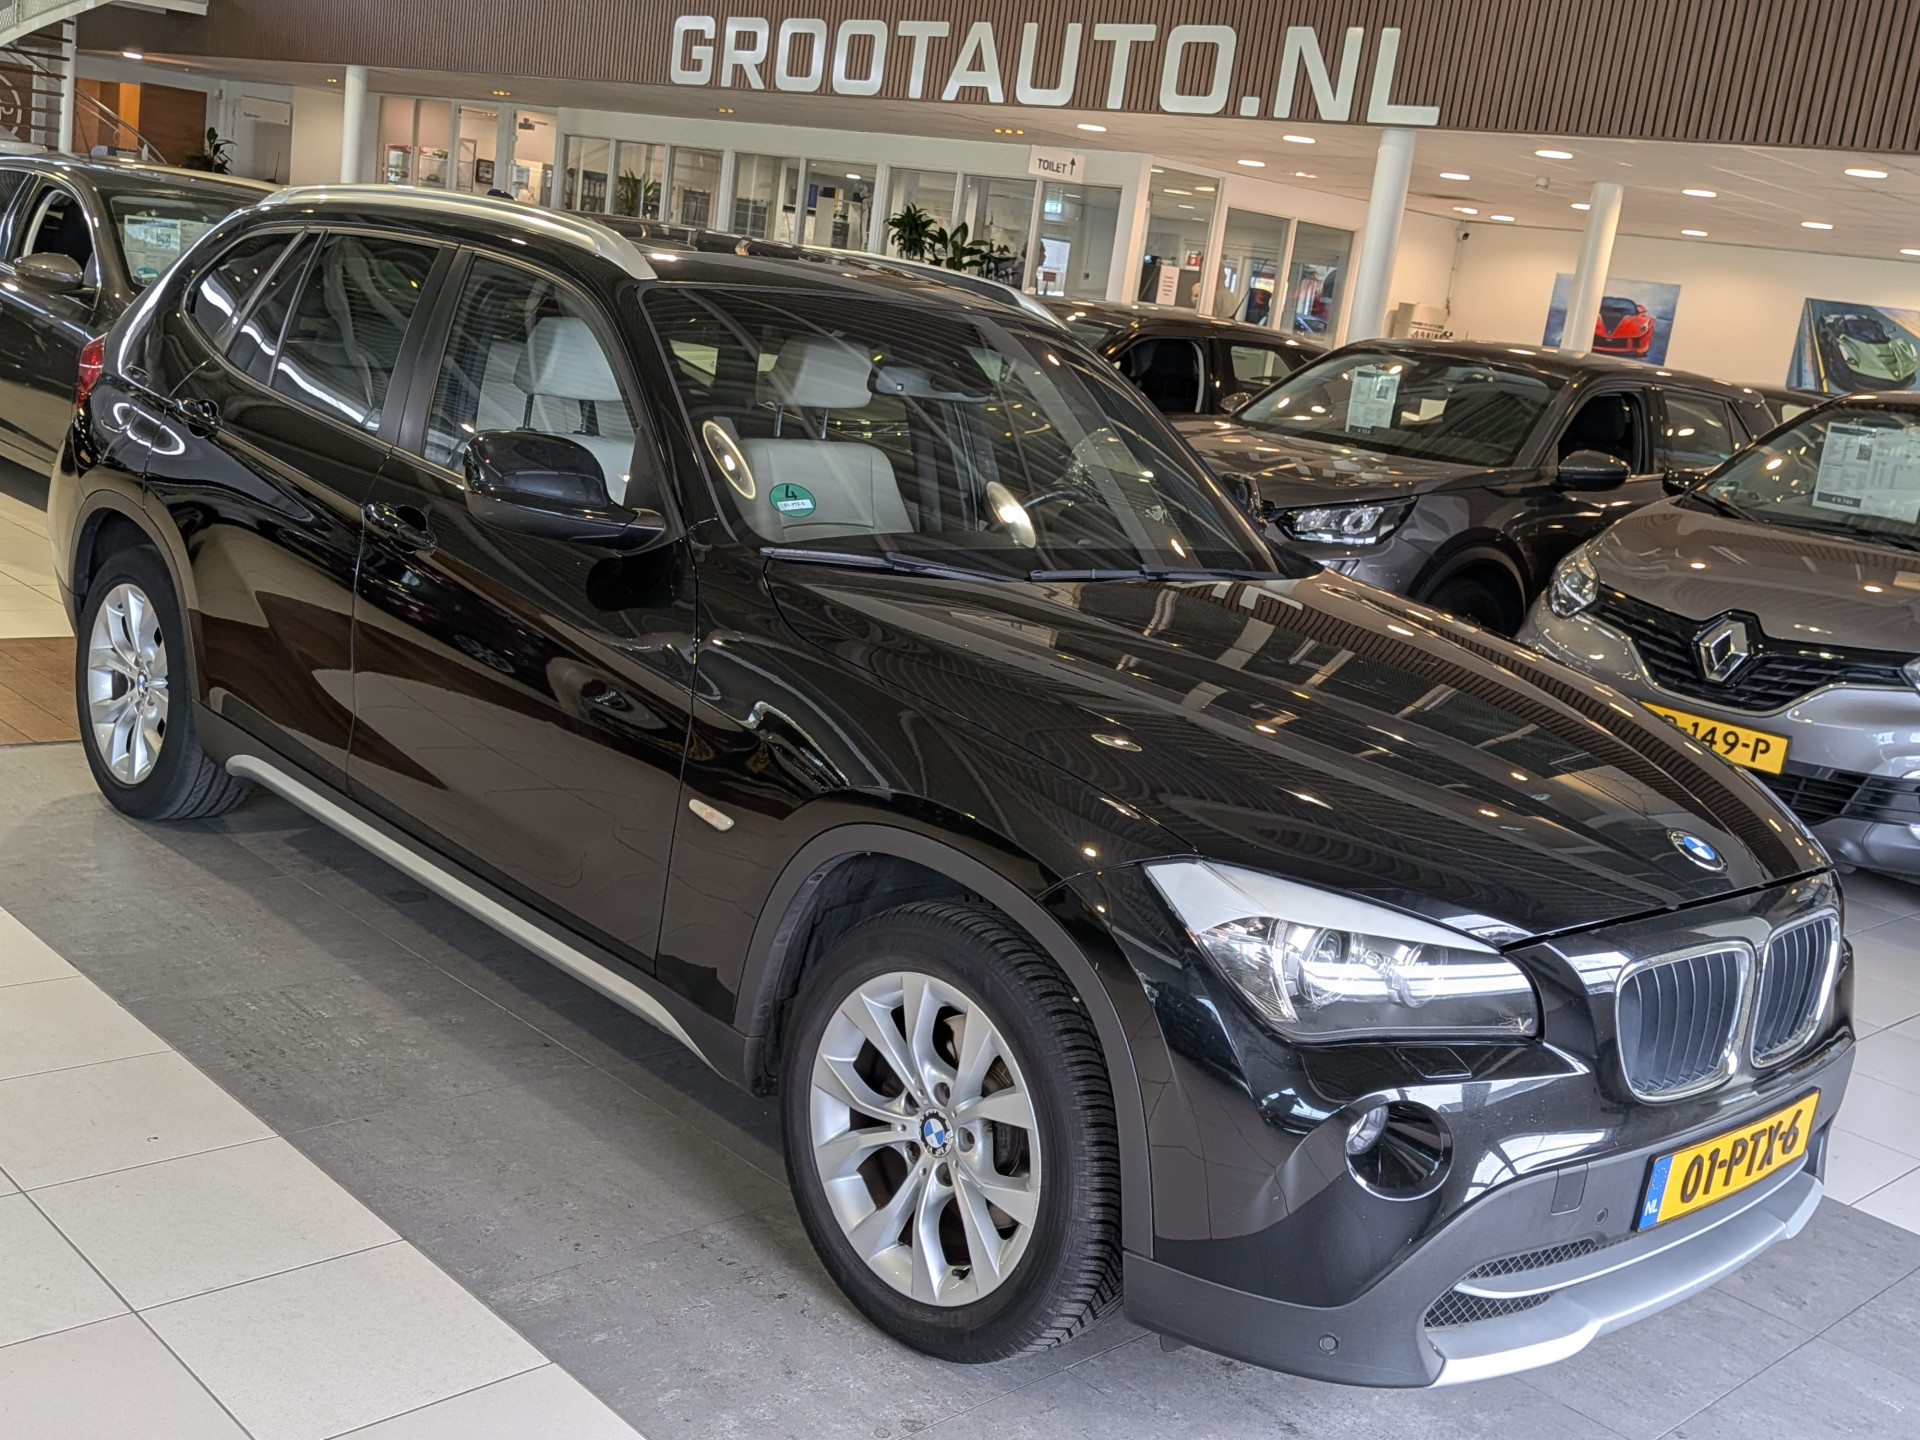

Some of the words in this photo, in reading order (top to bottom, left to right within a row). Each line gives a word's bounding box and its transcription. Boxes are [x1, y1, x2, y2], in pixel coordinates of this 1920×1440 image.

[670, 15, 1440, 126] GROOTAUTO.NL
[1038, 158, 1067, 174] TOILET
[785, 485, 798, 500] 4
[1680, 1109, 1803, 1203] 01-PTX-6
[1644, 1199, 1658, 1216] NL
